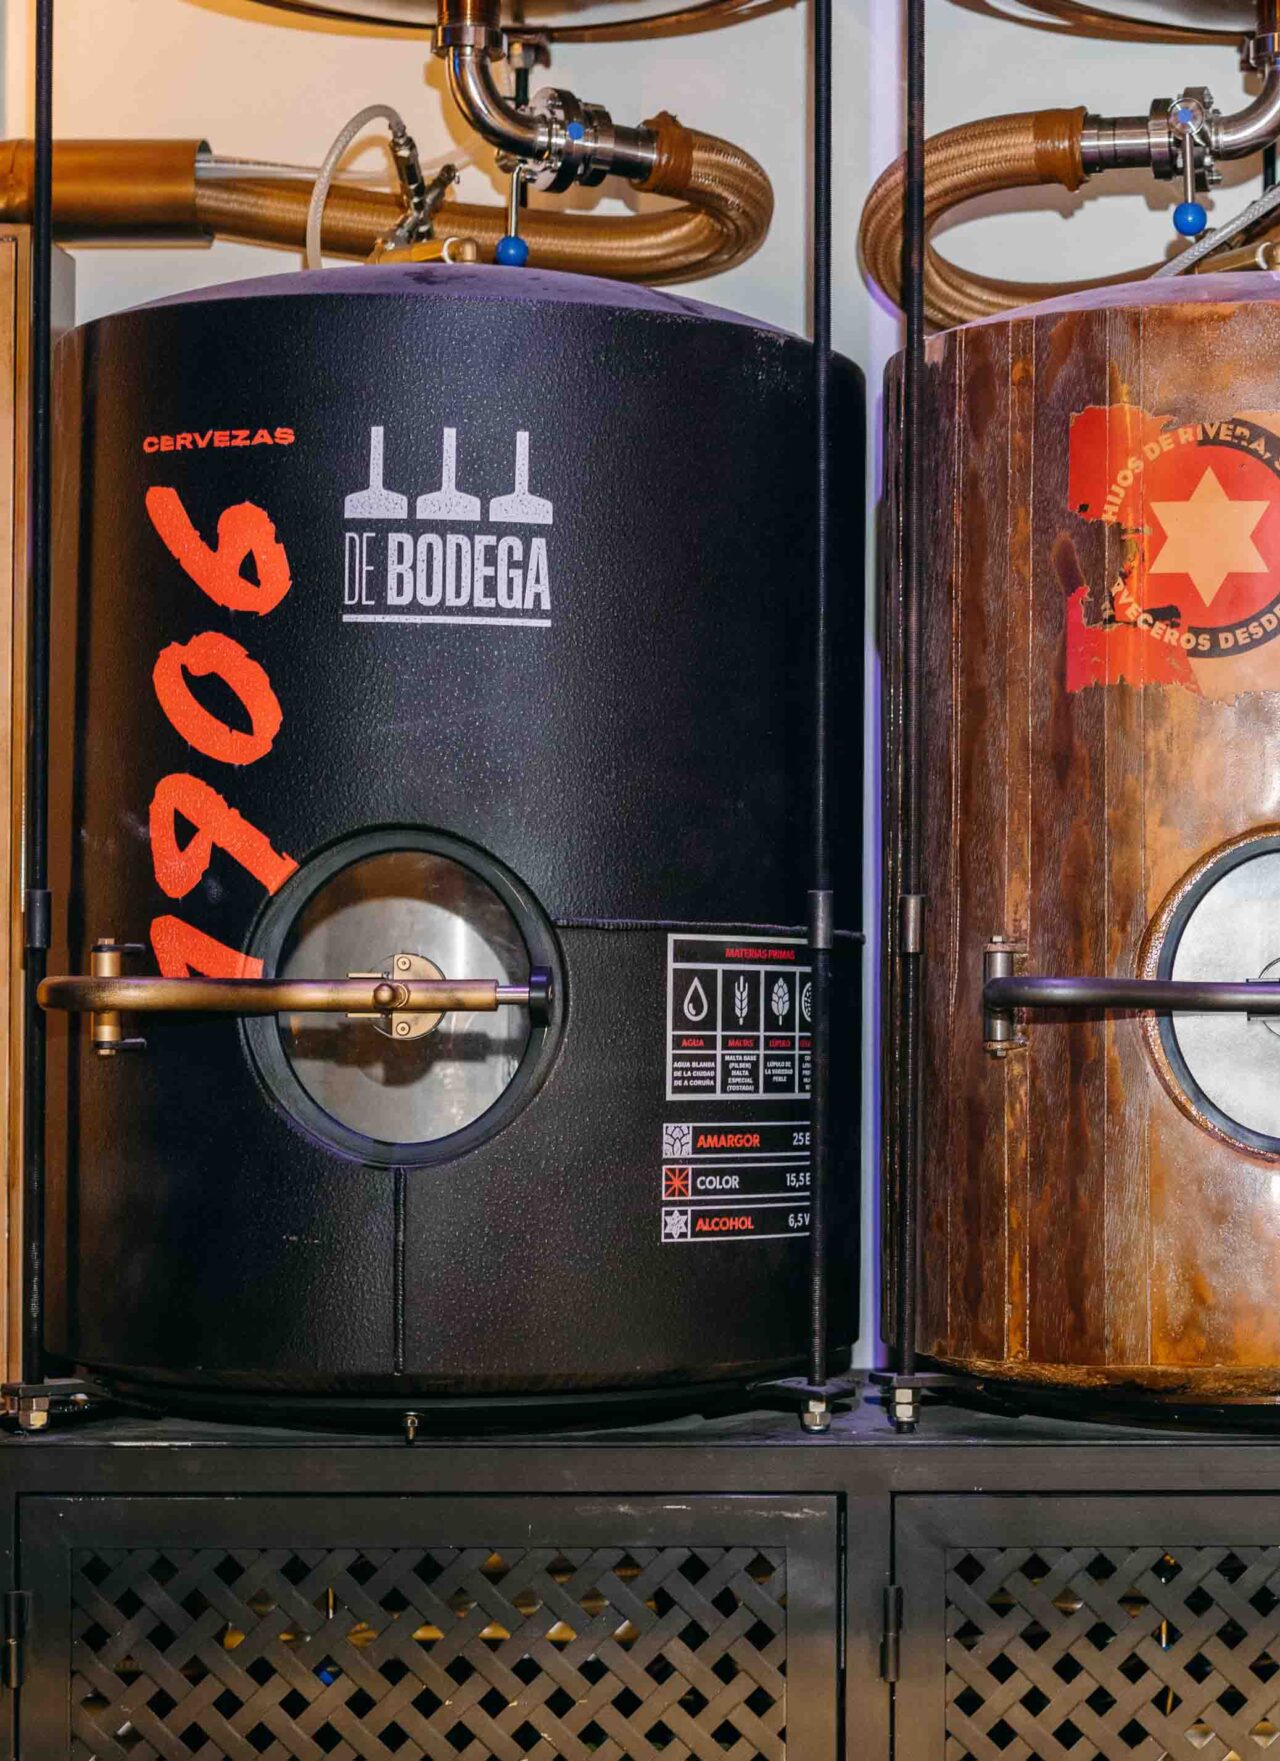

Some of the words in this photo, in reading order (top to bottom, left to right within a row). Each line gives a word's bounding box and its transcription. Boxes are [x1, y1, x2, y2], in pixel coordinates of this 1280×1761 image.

[142, 427, 296, 453] CERVEZAS
[1102, 456, 1144, 522] HIJOS
[1144, 433, 1175, 461] DE
[344, 532, 376, 606] DE
[386, 533, 552, 610] BODEGA
[725, 948, 767, 959] MATERIAS
[769, 949, 795, 960] PRIMAS
[682, 1038, 704, 1047] AGUA
[697, 1133, 760, 1148] AMARGOR
[697, 1176, 739, 1190] COLOR
[696, 1217, 754, 1231] ALCOHOL
